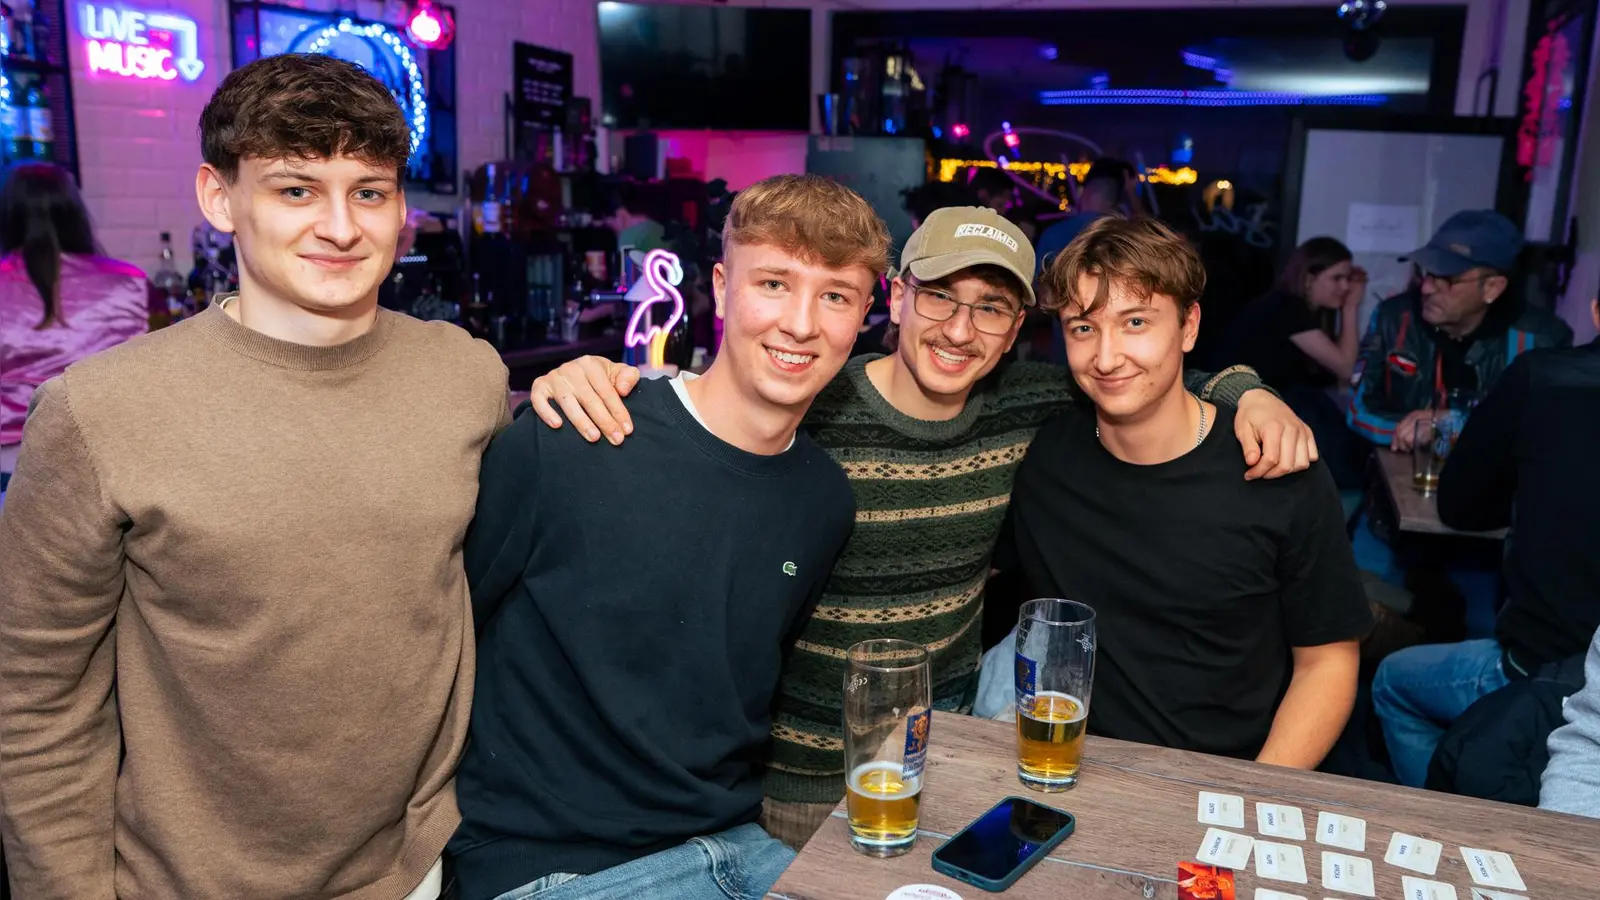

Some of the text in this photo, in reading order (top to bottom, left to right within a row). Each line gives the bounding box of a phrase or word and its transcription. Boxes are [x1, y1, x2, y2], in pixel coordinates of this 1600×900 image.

[84, 4, 149, 45] LIVE
[88, 39, 178, 80] MUSIC
[955, 224, 1018, 252] RECLAIMED
